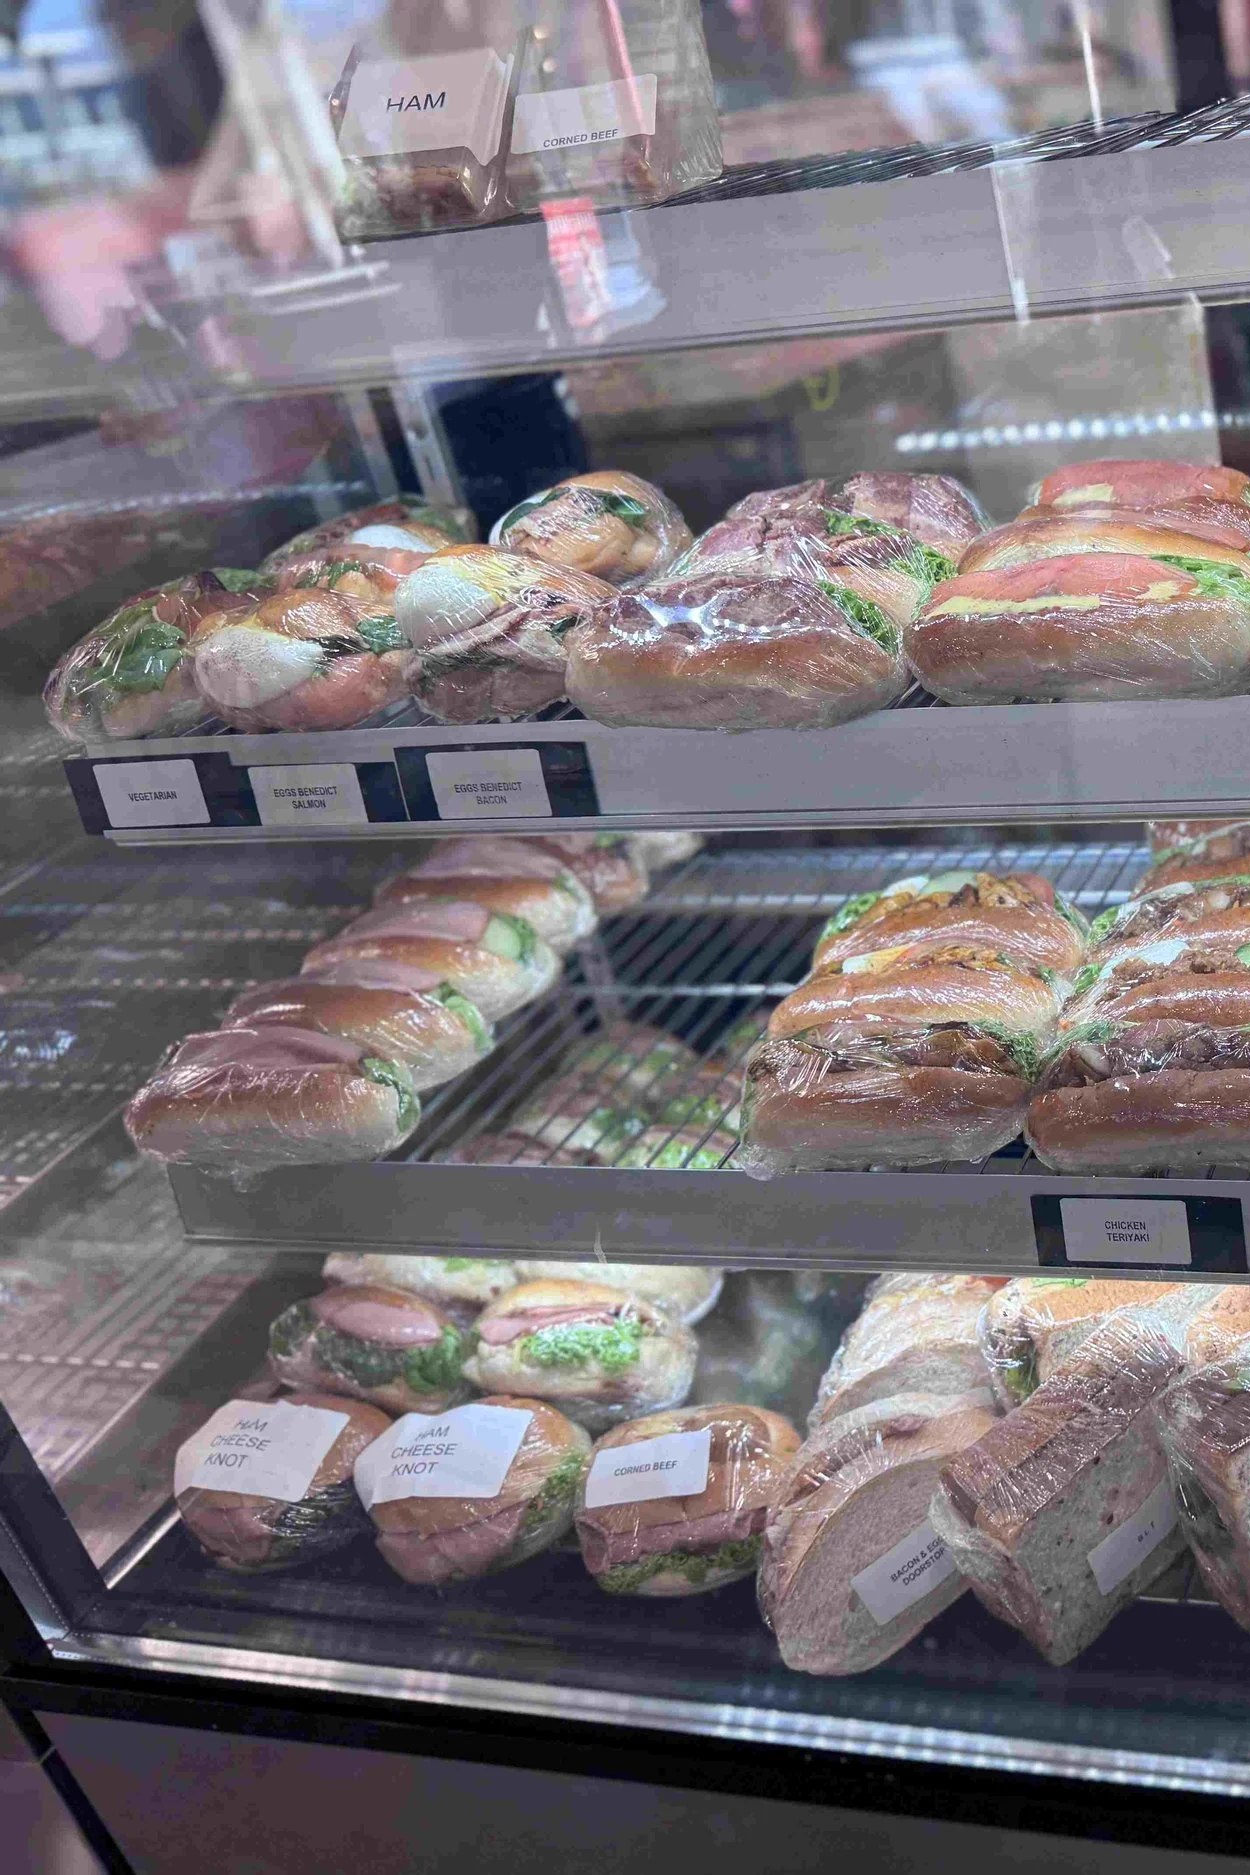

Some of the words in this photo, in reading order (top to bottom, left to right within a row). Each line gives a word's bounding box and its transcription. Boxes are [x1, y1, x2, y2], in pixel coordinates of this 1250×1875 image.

[386, 91, 446, 112] HAM
[543, 134, 588, 148] CORNED
[591, 128, 619, 140] BEEF
[273, 788, 297, 798] EGGS
[298, 786, 338, 797] BENEDICT
[454, 784, 479, 793] EGGS
[480, 782, 522, 792] BENEDICT
[128, 790, 177, 802] VEGETARIAN
[476, 796, 508, 805] BACON
[292, 800, 326, 809] SALMON
[1104, 1220, 1146, 1230] CHICKEN
[1106, 1232, 1150, 1242] TERIYAKI
[234, 1418, 268, 1432] HAM
[414, 1425, 450, 1442] HAM
[210, 1434, 271, 1451] CHEESE
[391, 1443, 457, 1459] CHEESE
[204, 1453, 249, 1468] KNOT
[614, 1463, 650, 1476] CORNED
[652, 1460, 678, 1471] BEEF
[391, 1462, 439, 1477] KNOT
[889, 1555, 920, 1583] BACON
